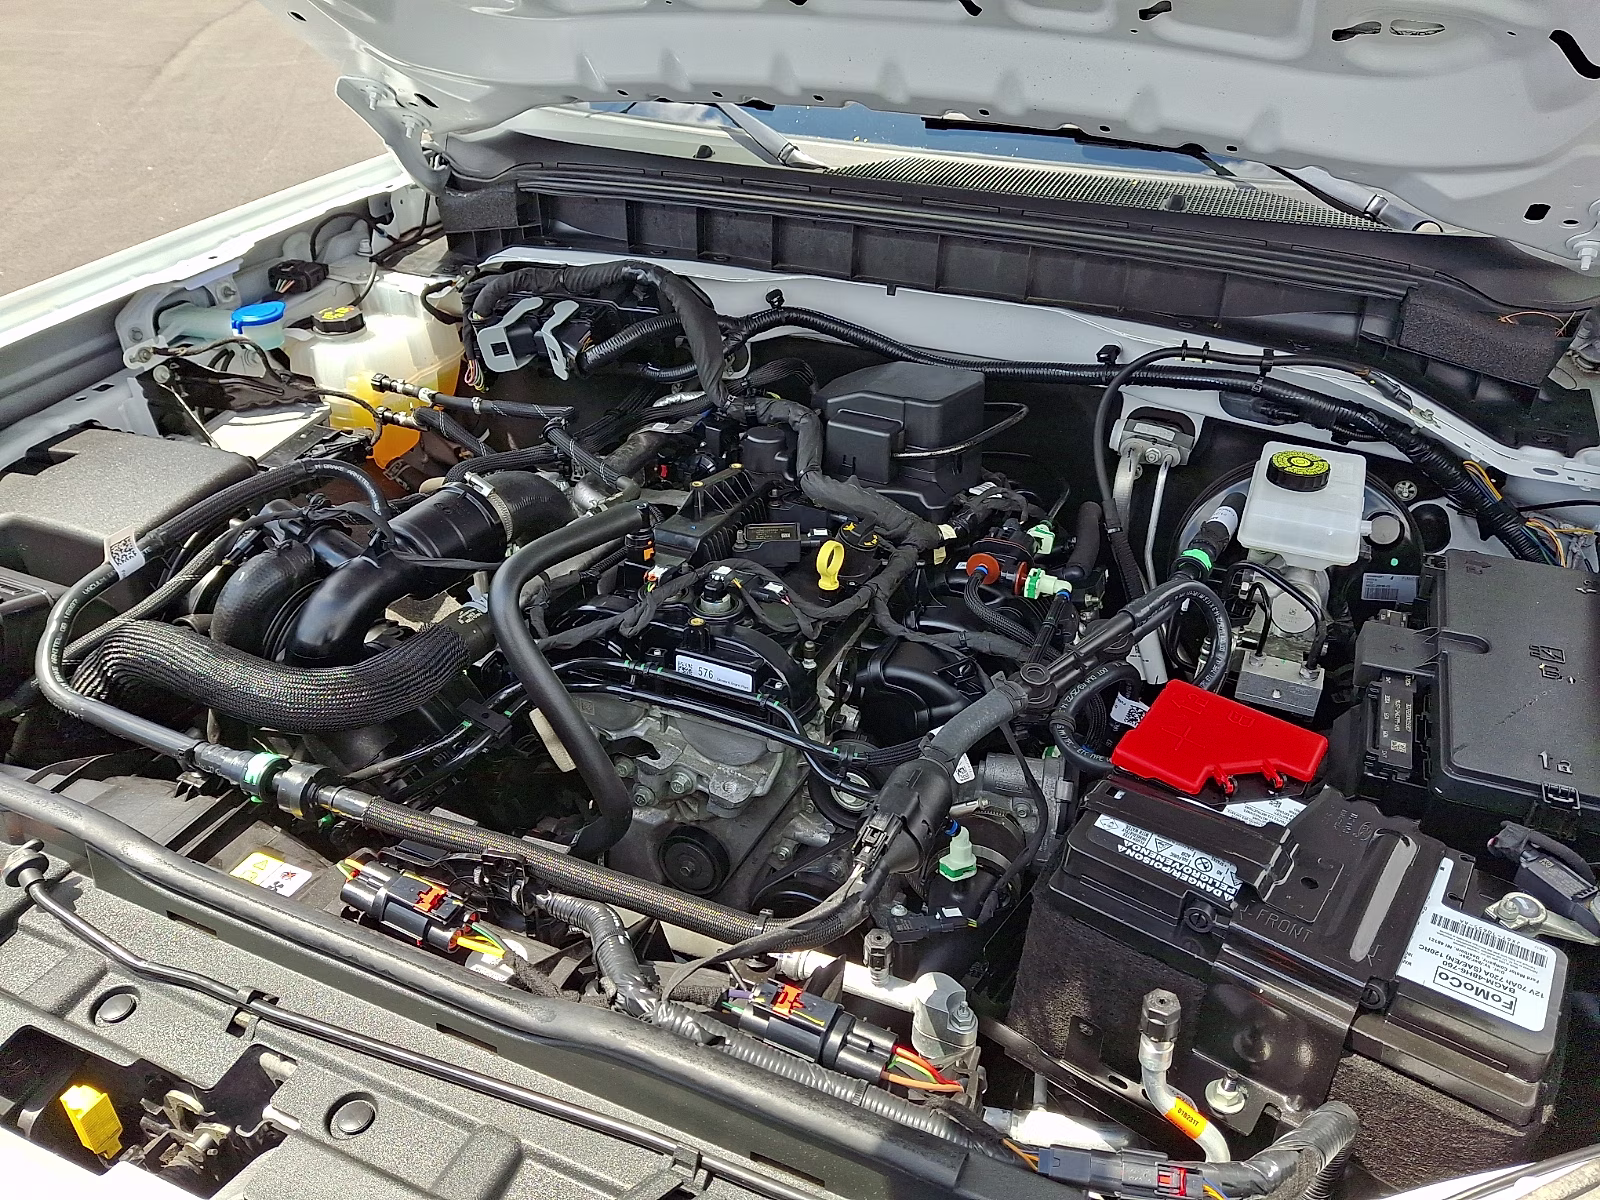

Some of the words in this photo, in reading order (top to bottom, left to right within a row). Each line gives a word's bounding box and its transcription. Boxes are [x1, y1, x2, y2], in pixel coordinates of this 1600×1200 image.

[698, 667, 714, 680] 576
[1125, 848, 1221, 896] DANGER/POISON
[1131, 843, 1235, 894] PELIGRO/VENENO
[1255, 908, 1313, 942] FRONT
[1418, 944, 1443, 957] 120RC
[1445, 953, 1482, 973] (SAE/EN)
[1442, 960, 1515, 993] BAGM-48H6-760
[1482, 969, 1504, 982] 720A
[1505, 978, 1527, 991] 70Ah
[1437, 971, 1513, 1010] FoMoCo
[1529, 988, 1544, 998] 12V
